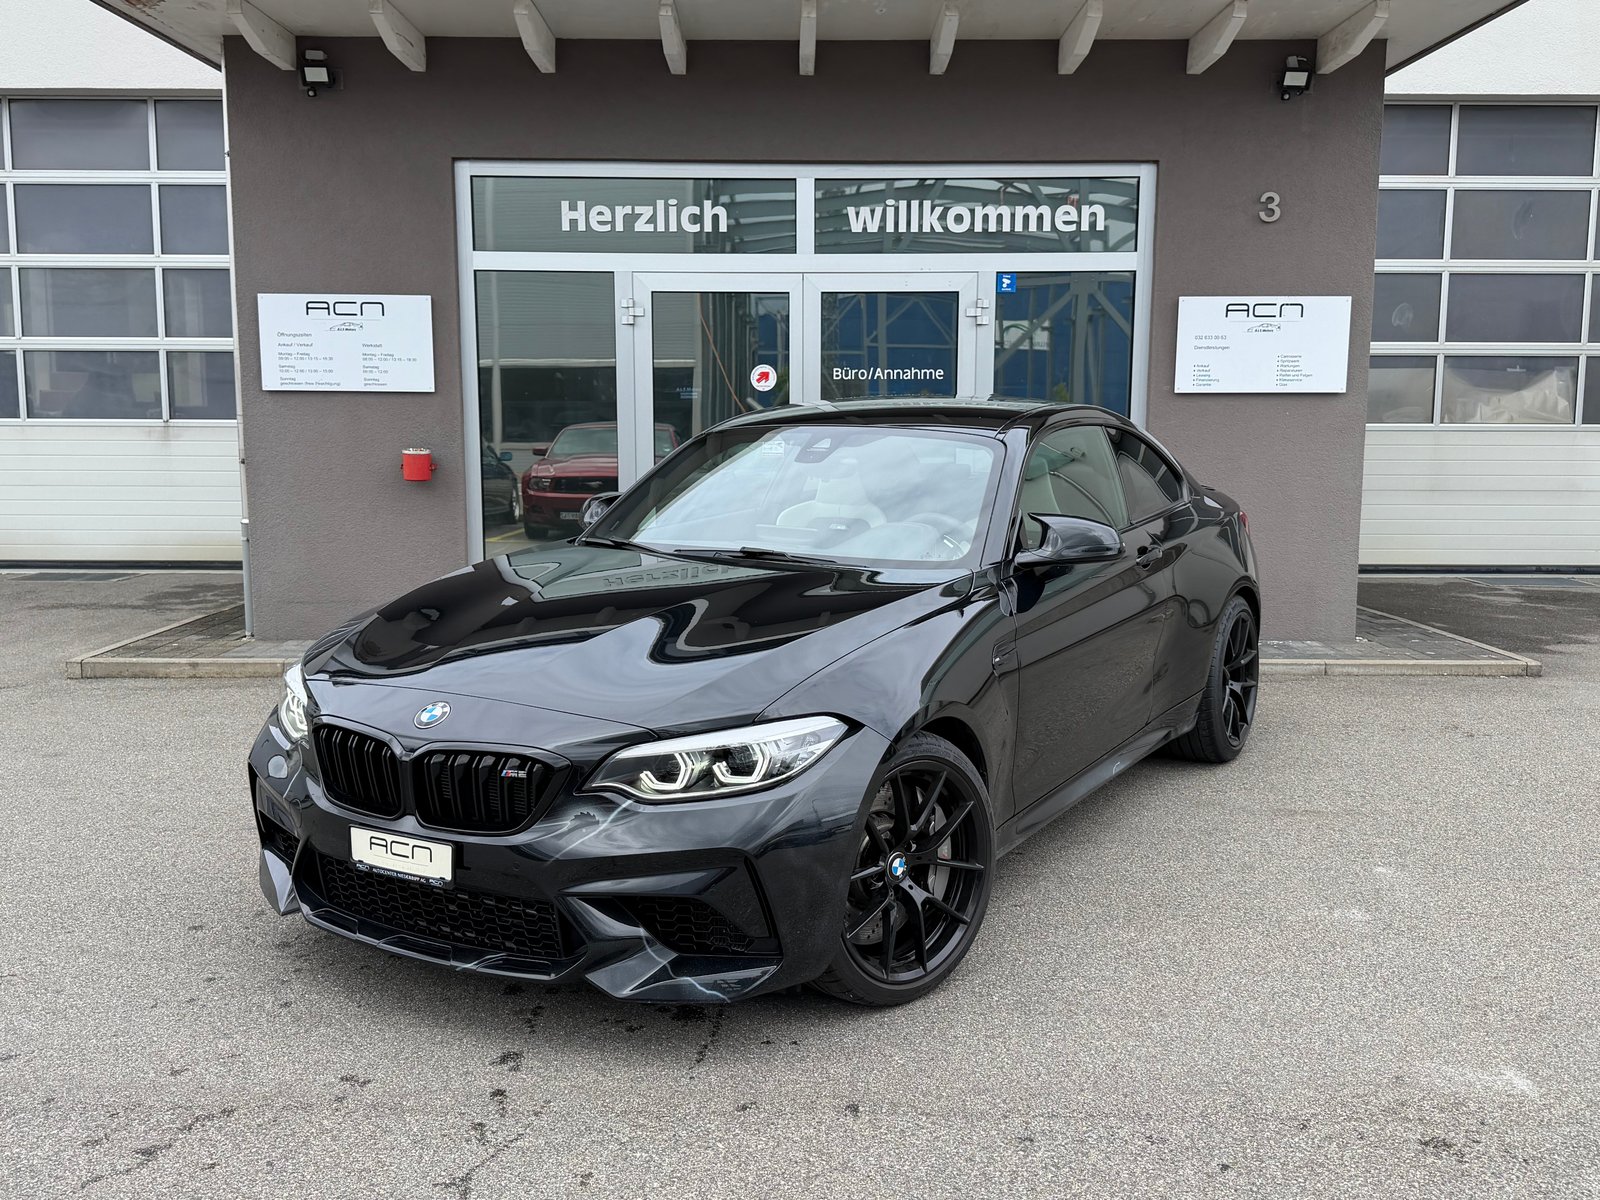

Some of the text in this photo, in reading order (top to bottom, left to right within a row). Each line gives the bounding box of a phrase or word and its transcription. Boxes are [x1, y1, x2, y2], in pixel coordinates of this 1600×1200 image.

[1259, 191, 1280, 223] 3
[561, 200, 1105, 232] Herzlich willkommen
[306, 301, 384, 316] ACN
[1226, 303, 1304, 317] ACN
[832, 367, 944, 381] Büro/Annahme
[370, 836, 432, 862] ACN
[372, 868, 397, 876] AUTOCENTER
